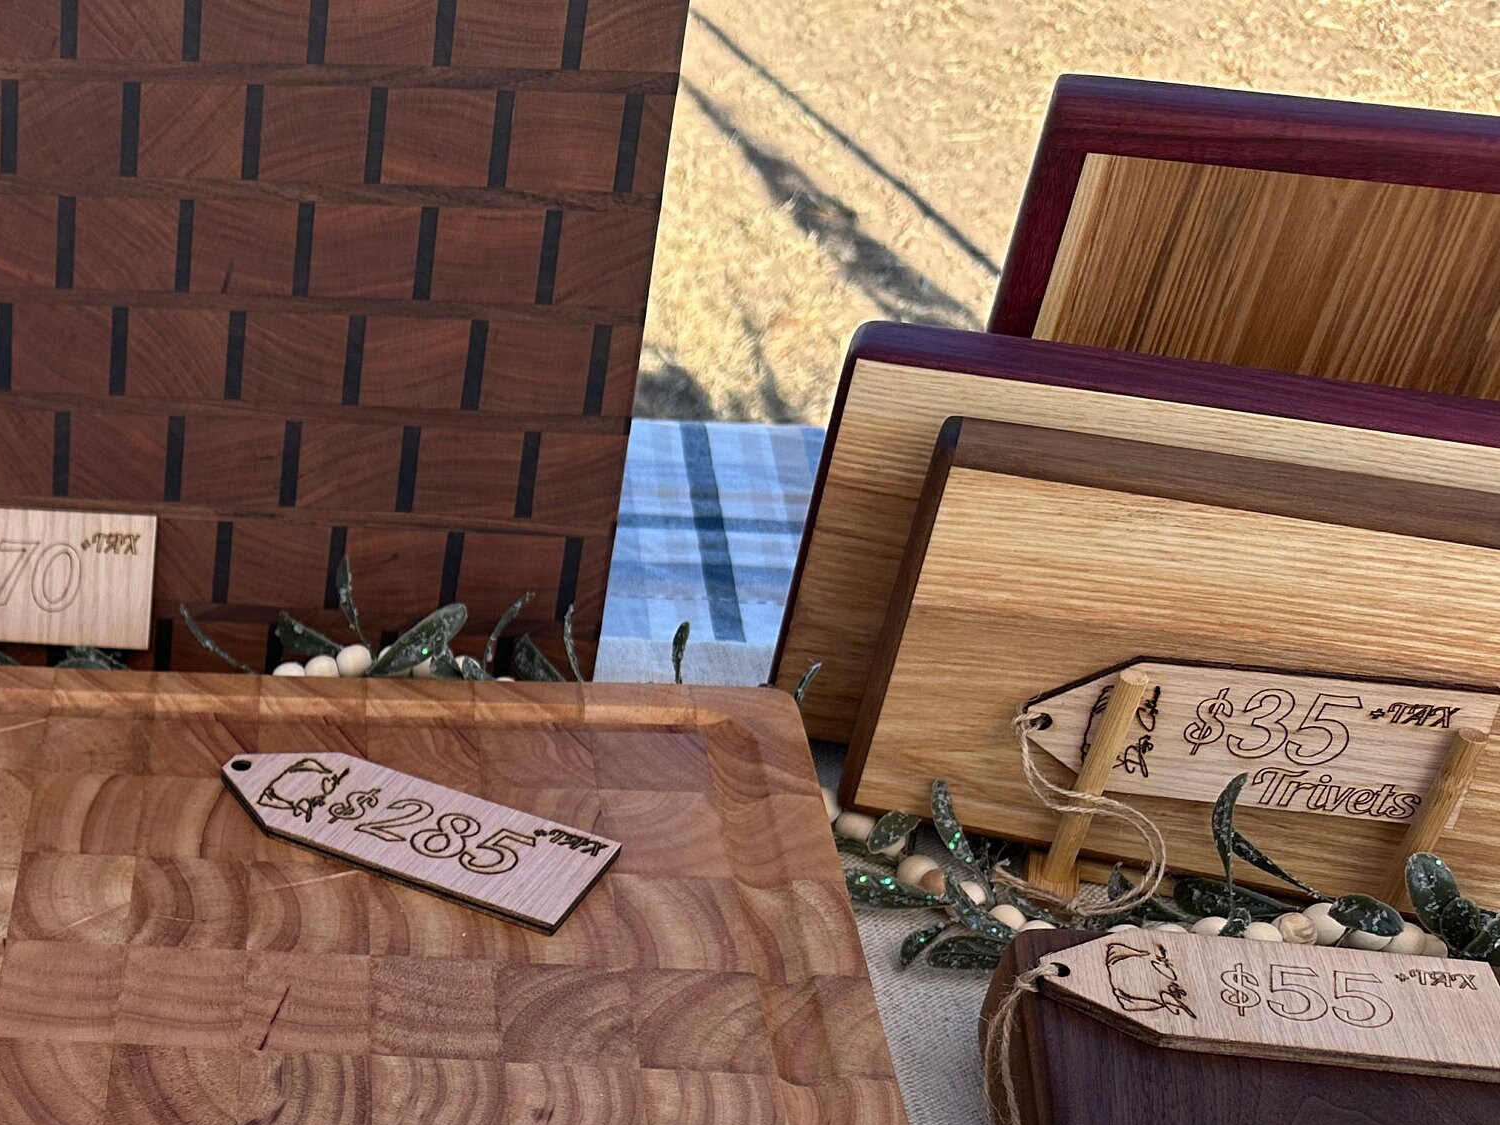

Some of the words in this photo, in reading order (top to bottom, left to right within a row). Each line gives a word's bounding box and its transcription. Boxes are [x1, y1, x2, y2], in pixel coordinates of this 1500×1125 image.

[1183, 687, 1364, 766] $35
[1368, 700, 1463, 729] +TAX
[1251, 765, 1422, 820] Trivets
[328, 788, 537, 875] $285
[1219, 962, 1394, 1029] $55
